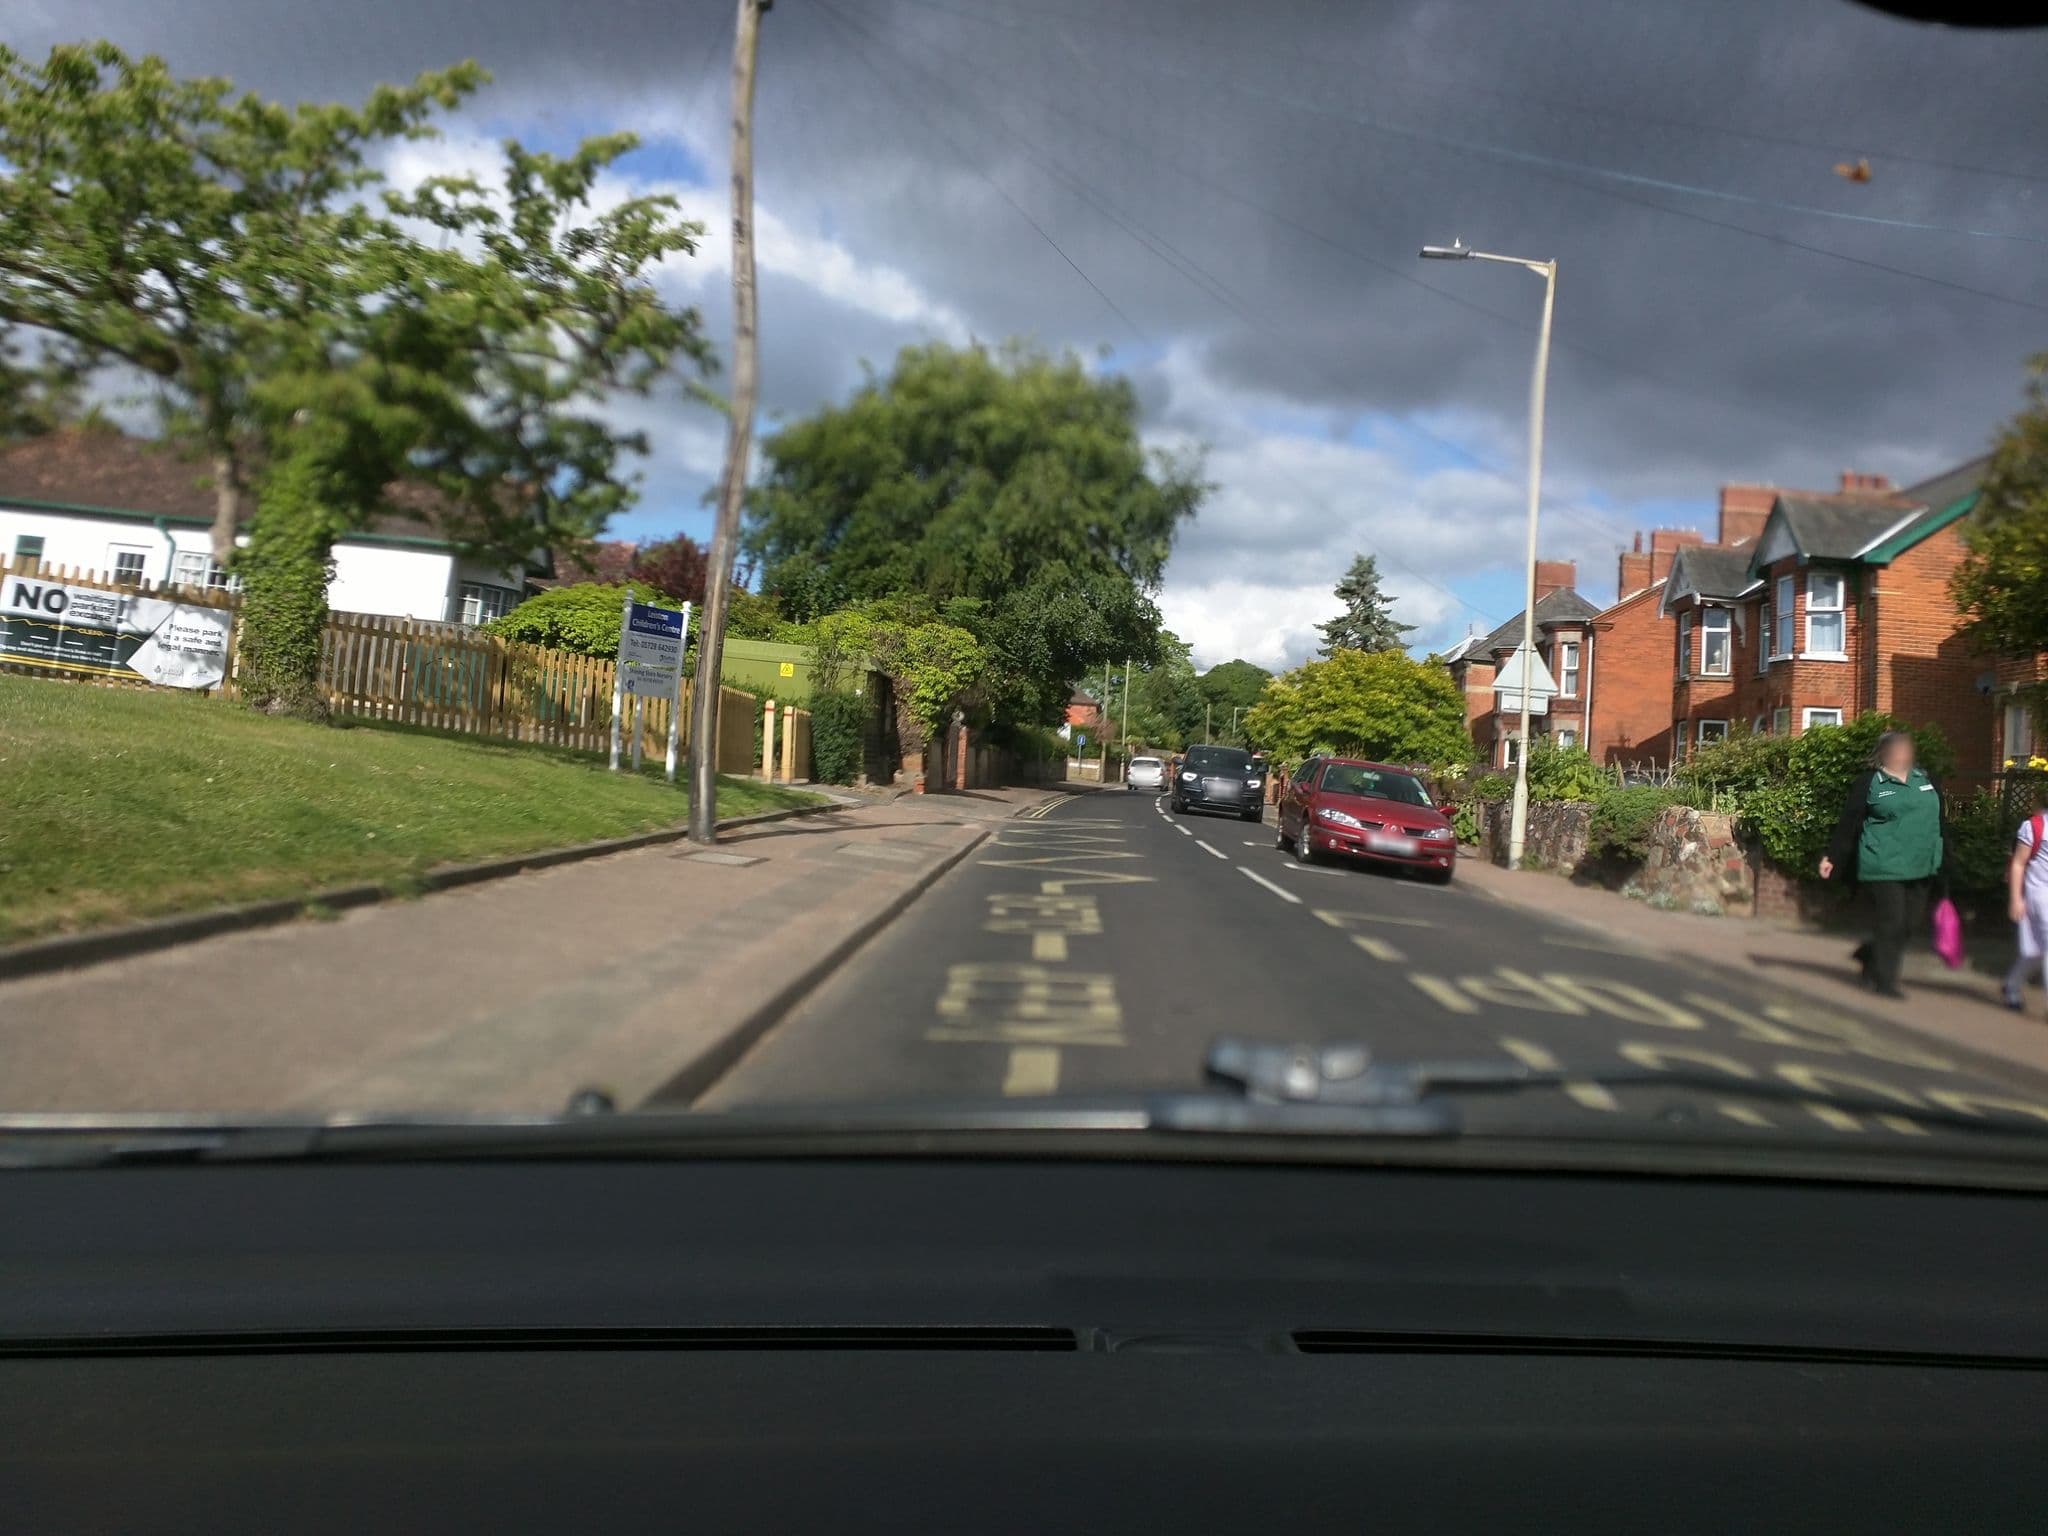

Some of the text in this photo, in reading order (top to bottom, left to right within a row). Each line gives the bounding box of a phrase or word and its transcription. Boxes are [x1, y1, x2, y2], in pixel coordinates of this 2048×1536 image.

[13, 583, 69, 614] NO
[73, 593, 116, 607] waiting
[70, 602, 117, 616] parking
[69, 610, 112, 621] excuse
[169, 624, 200, 634] Please
[661, 624, 680, 635] Centre
[158, 641, 181, 652] legal
[182, 636, 202, 645] safe
[205, 639, 221, 647] and
